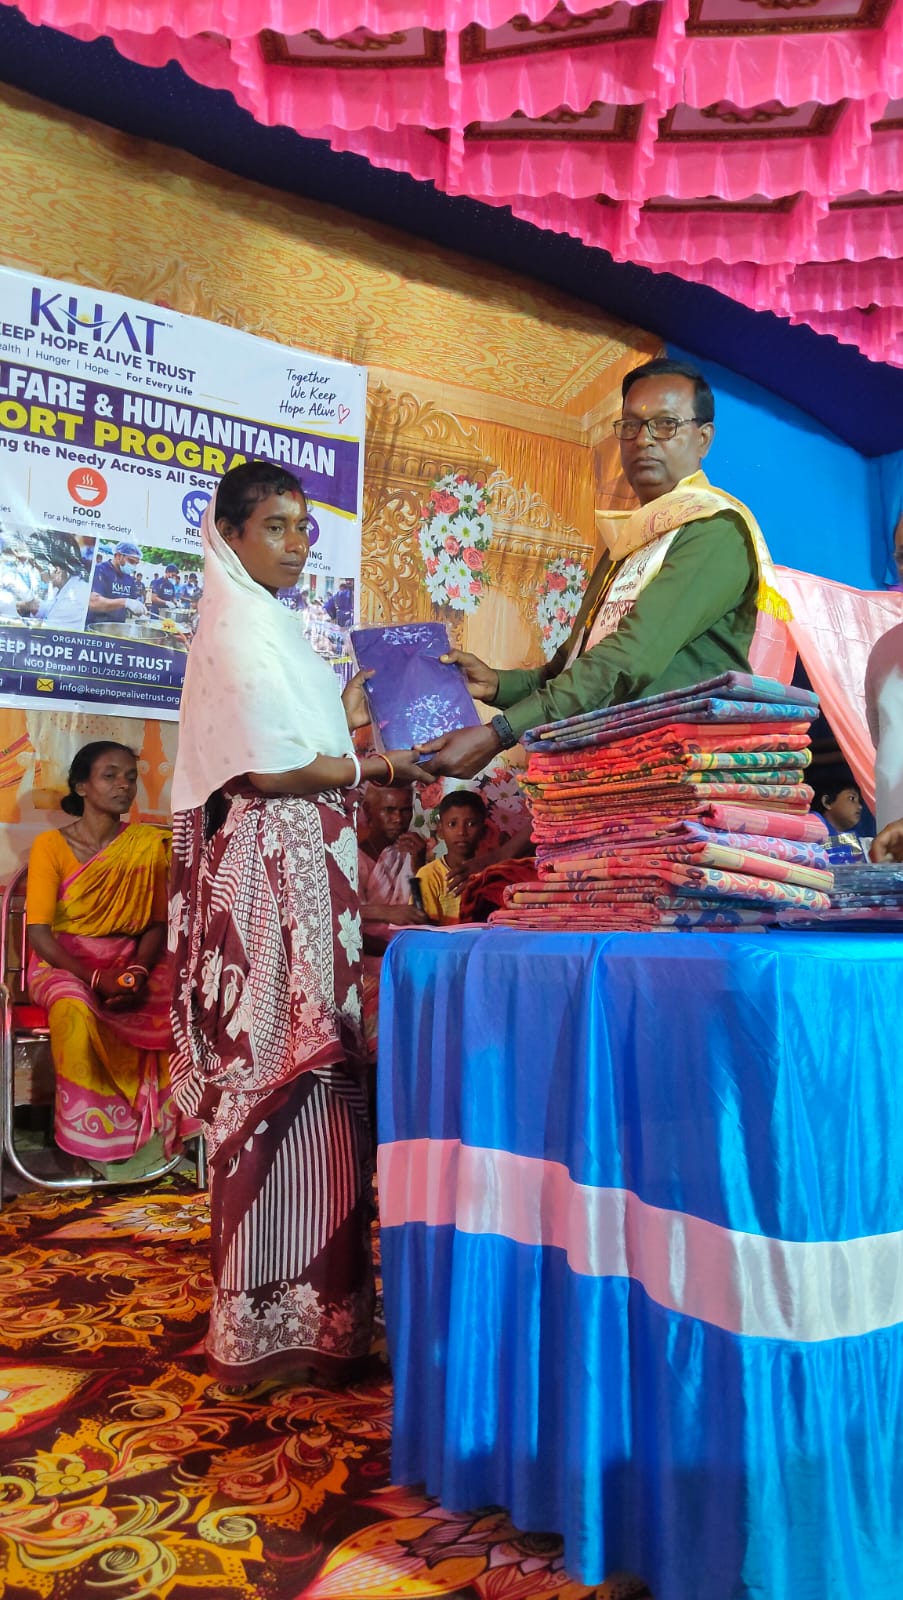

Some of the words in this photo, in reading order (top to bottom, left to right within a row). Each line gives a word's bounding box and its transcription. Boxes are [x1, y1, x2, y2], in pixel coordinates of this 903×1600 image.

[31, 287, 165, 356] KHAT
[0, 321, 35, 341] EEP
[41, 332, 89, 356] HOPE
[93, 346, 142, 370] ALIVE
[147, 359, 197, 383] TRUST
[0, 343, 21, 354] alth
[36, 349, 71, 366] Hunger
[84, 362, 109, 375] Hope
[126, 372, 142, 383] For
[146, 377, 173, 392] Every
[175, 384, 193, 396] Life
[286, 368, 331, 387] Together
[290, 385, 306, 399] We
[309, 387, 337, 405] Keep
[279, 400, 305, 419] Hope
[308, 402, 336, 417] Alive
[0, 400, 84, 441] ORT
[94, 419, 282, 475] PROGRA
[93, 393, 114, 418] &
[123, 393, 336, 477] HUMANITARIAN
[23, 440, 51, 456] the
[55, 446, 106, 470] Needy
[110, 458, 162, 479] Across
[165, 470, 185, 484] All
[43, 511, 55, 520] For
[62, 516, 106, 530] Hunger-Free
[107, 523, 132, 535] Society
[73, 506, 102, 518] FOOD
[171, 535, 182, 543] For
[318, 562, 331, 571] Care
[52, 634, 103, 647] ORGANIZED
[105, 641, 116, 649] BY
[24, 657, 44, 668] NGO
[45, 660, 77, 674] Darpan
[78, 665, 90, 673] ID:
[30, 641, 74, 660] HOPE
[78, 648, 123, 666] ALIVE
[127, 655, 173, 672] TRUST
[60, 682, 180, 705] info@keephopealivetrust.org
